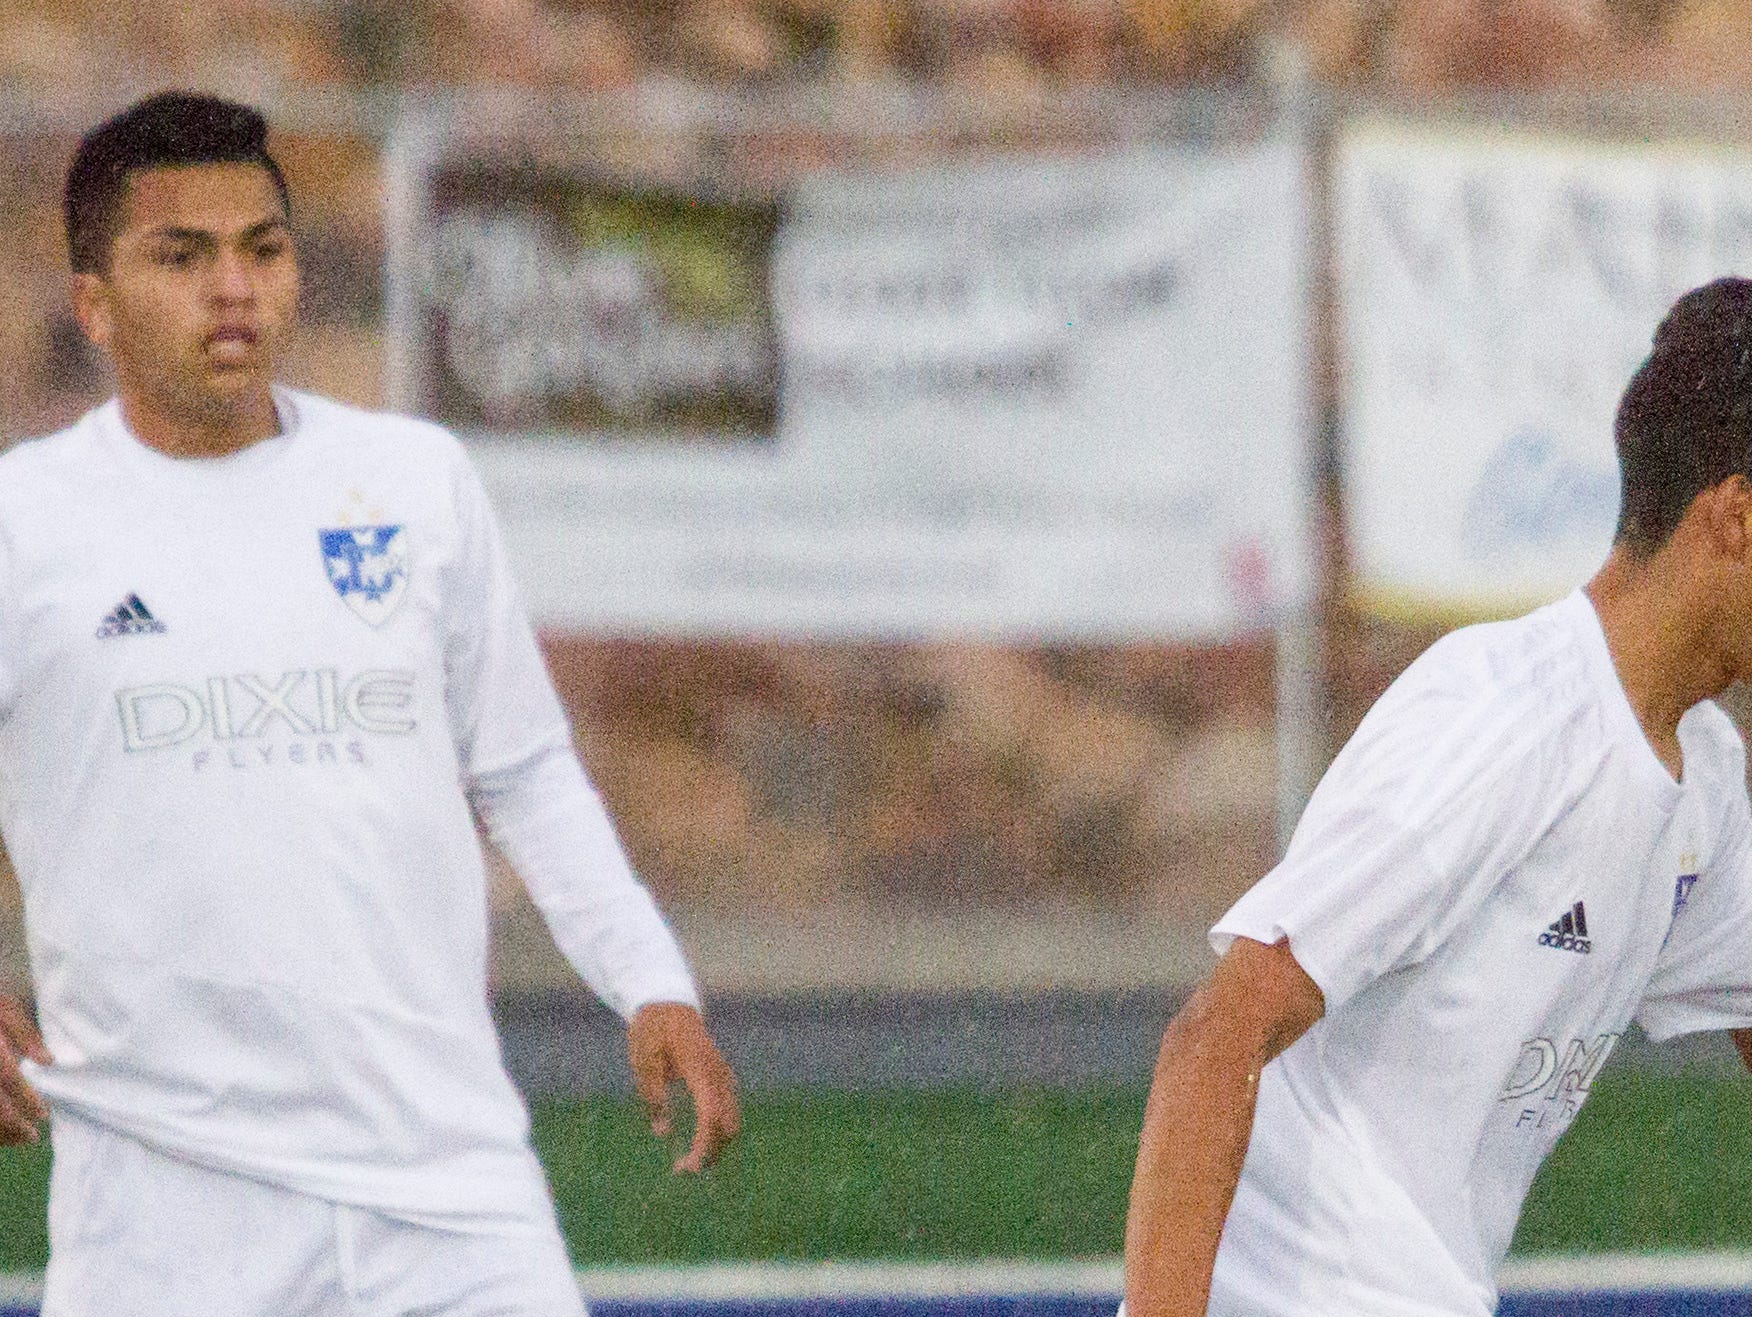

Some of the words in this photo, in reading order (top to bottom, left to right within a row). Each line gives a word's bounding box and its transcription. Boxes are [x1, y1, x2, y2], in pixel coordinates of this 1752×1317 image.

[113, 669, 418, 754] DIXIE
[193, 740, 366, 772] FLYERS
[1538, 932, 1592, 954] adidas
